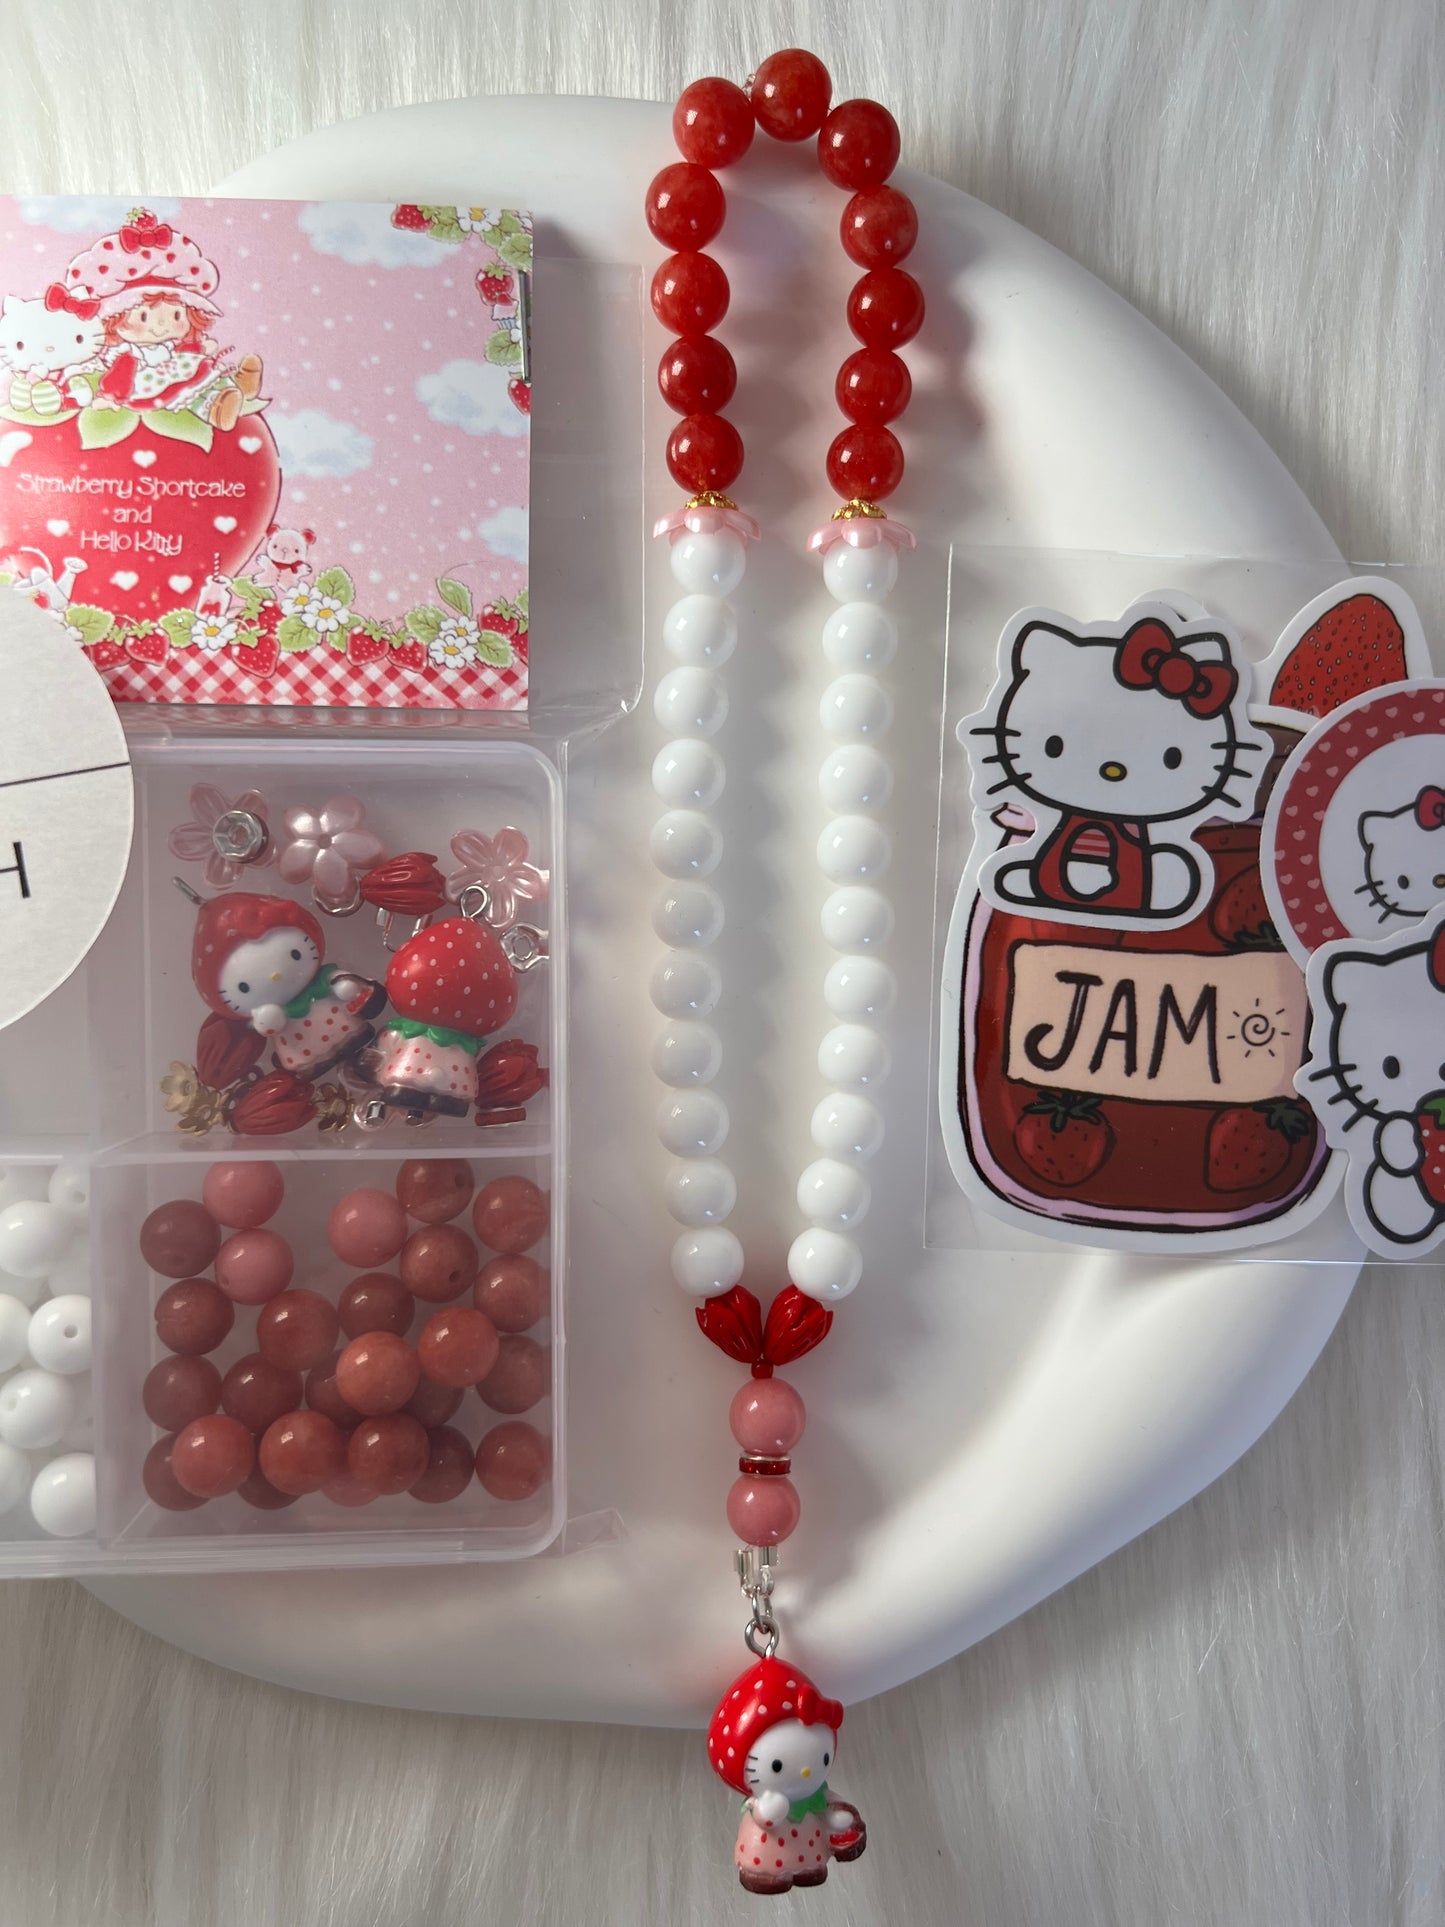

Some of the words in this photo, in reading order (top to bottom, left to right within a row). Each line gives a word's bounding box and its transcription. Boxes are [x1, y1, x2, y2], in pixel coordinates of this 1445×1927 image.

[16, 473, 132, 499] Strawberry
[137, 475, 246, 498] Shortcake
[112, 506, 152, 524] and
[80, 530, 131, 552] Hello
[134, 531, 182, 556] Kitty
[1024, 971, 1221, 1084] JAM
